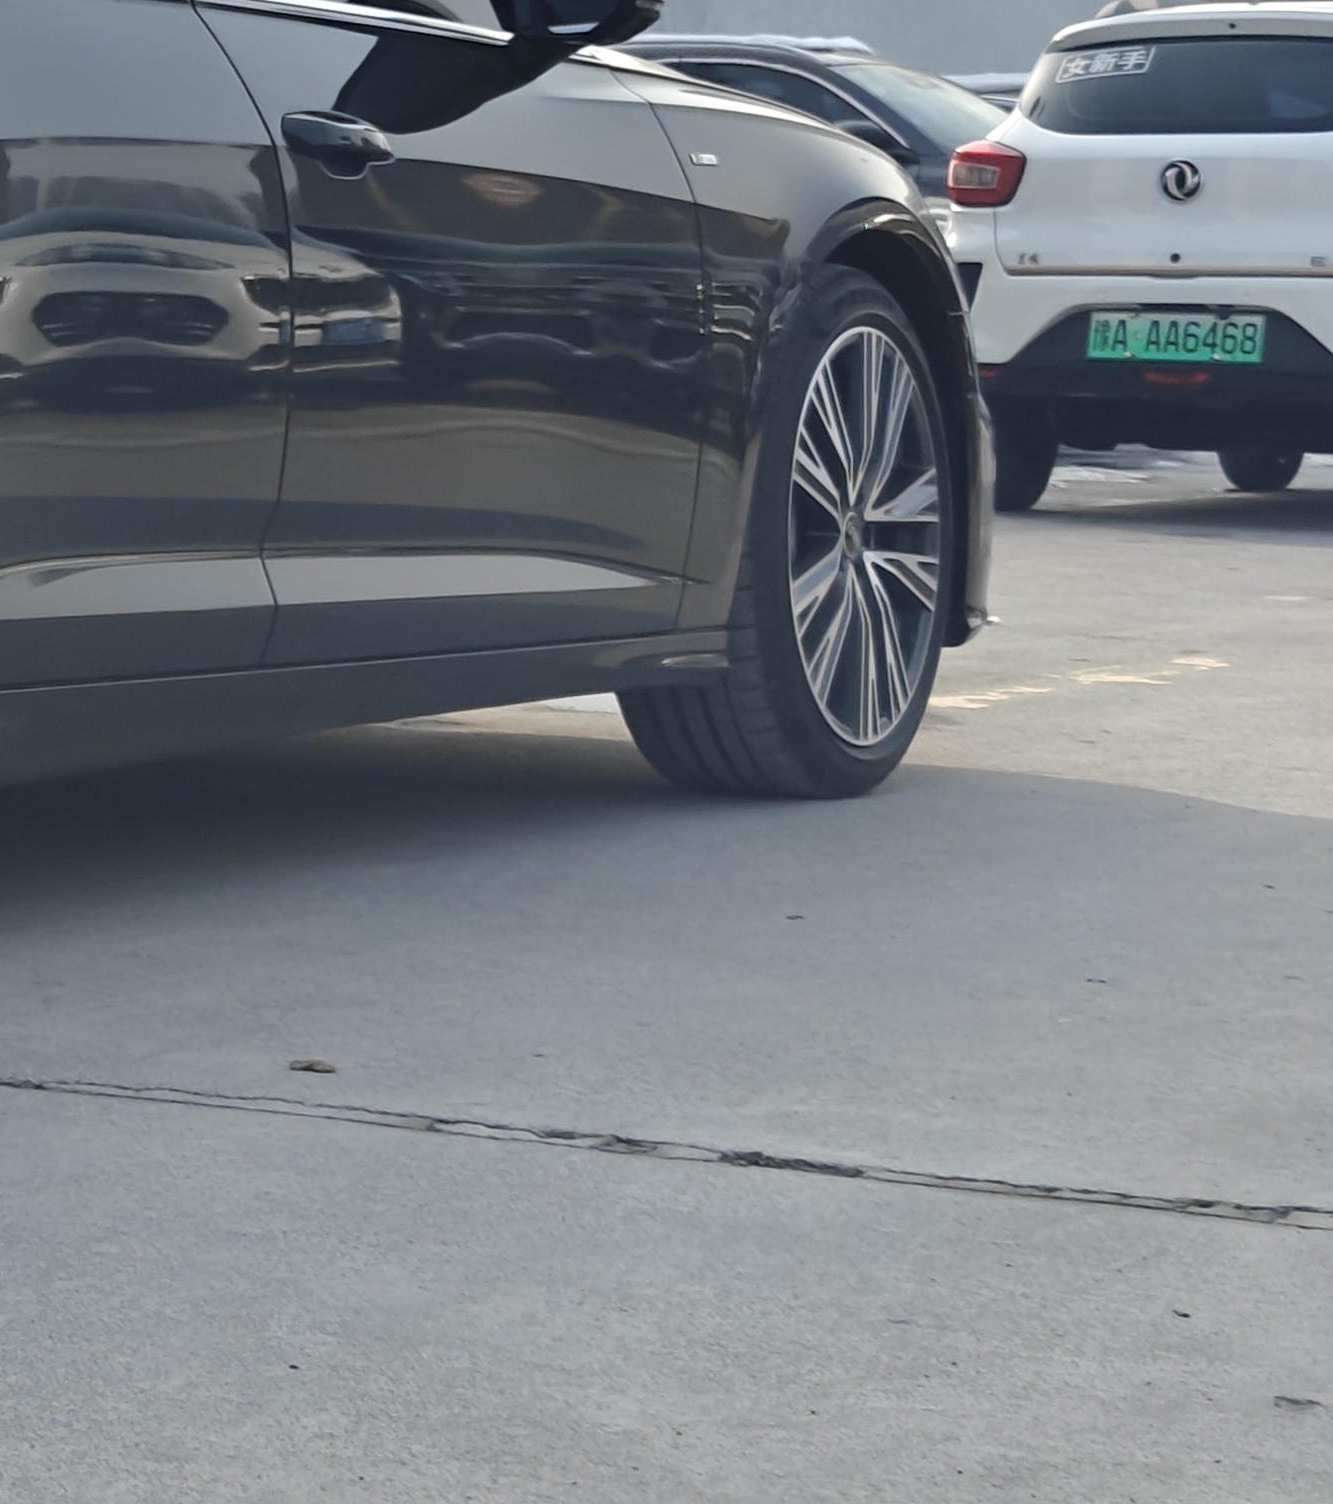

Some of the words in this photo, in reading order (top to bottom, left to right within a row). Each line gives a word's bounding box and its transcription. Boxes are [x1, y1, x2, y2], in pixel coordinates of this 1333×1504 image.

[1061, 50, 1147, 78] 女新手
[1145, 320, 1258, 355] AA6468
